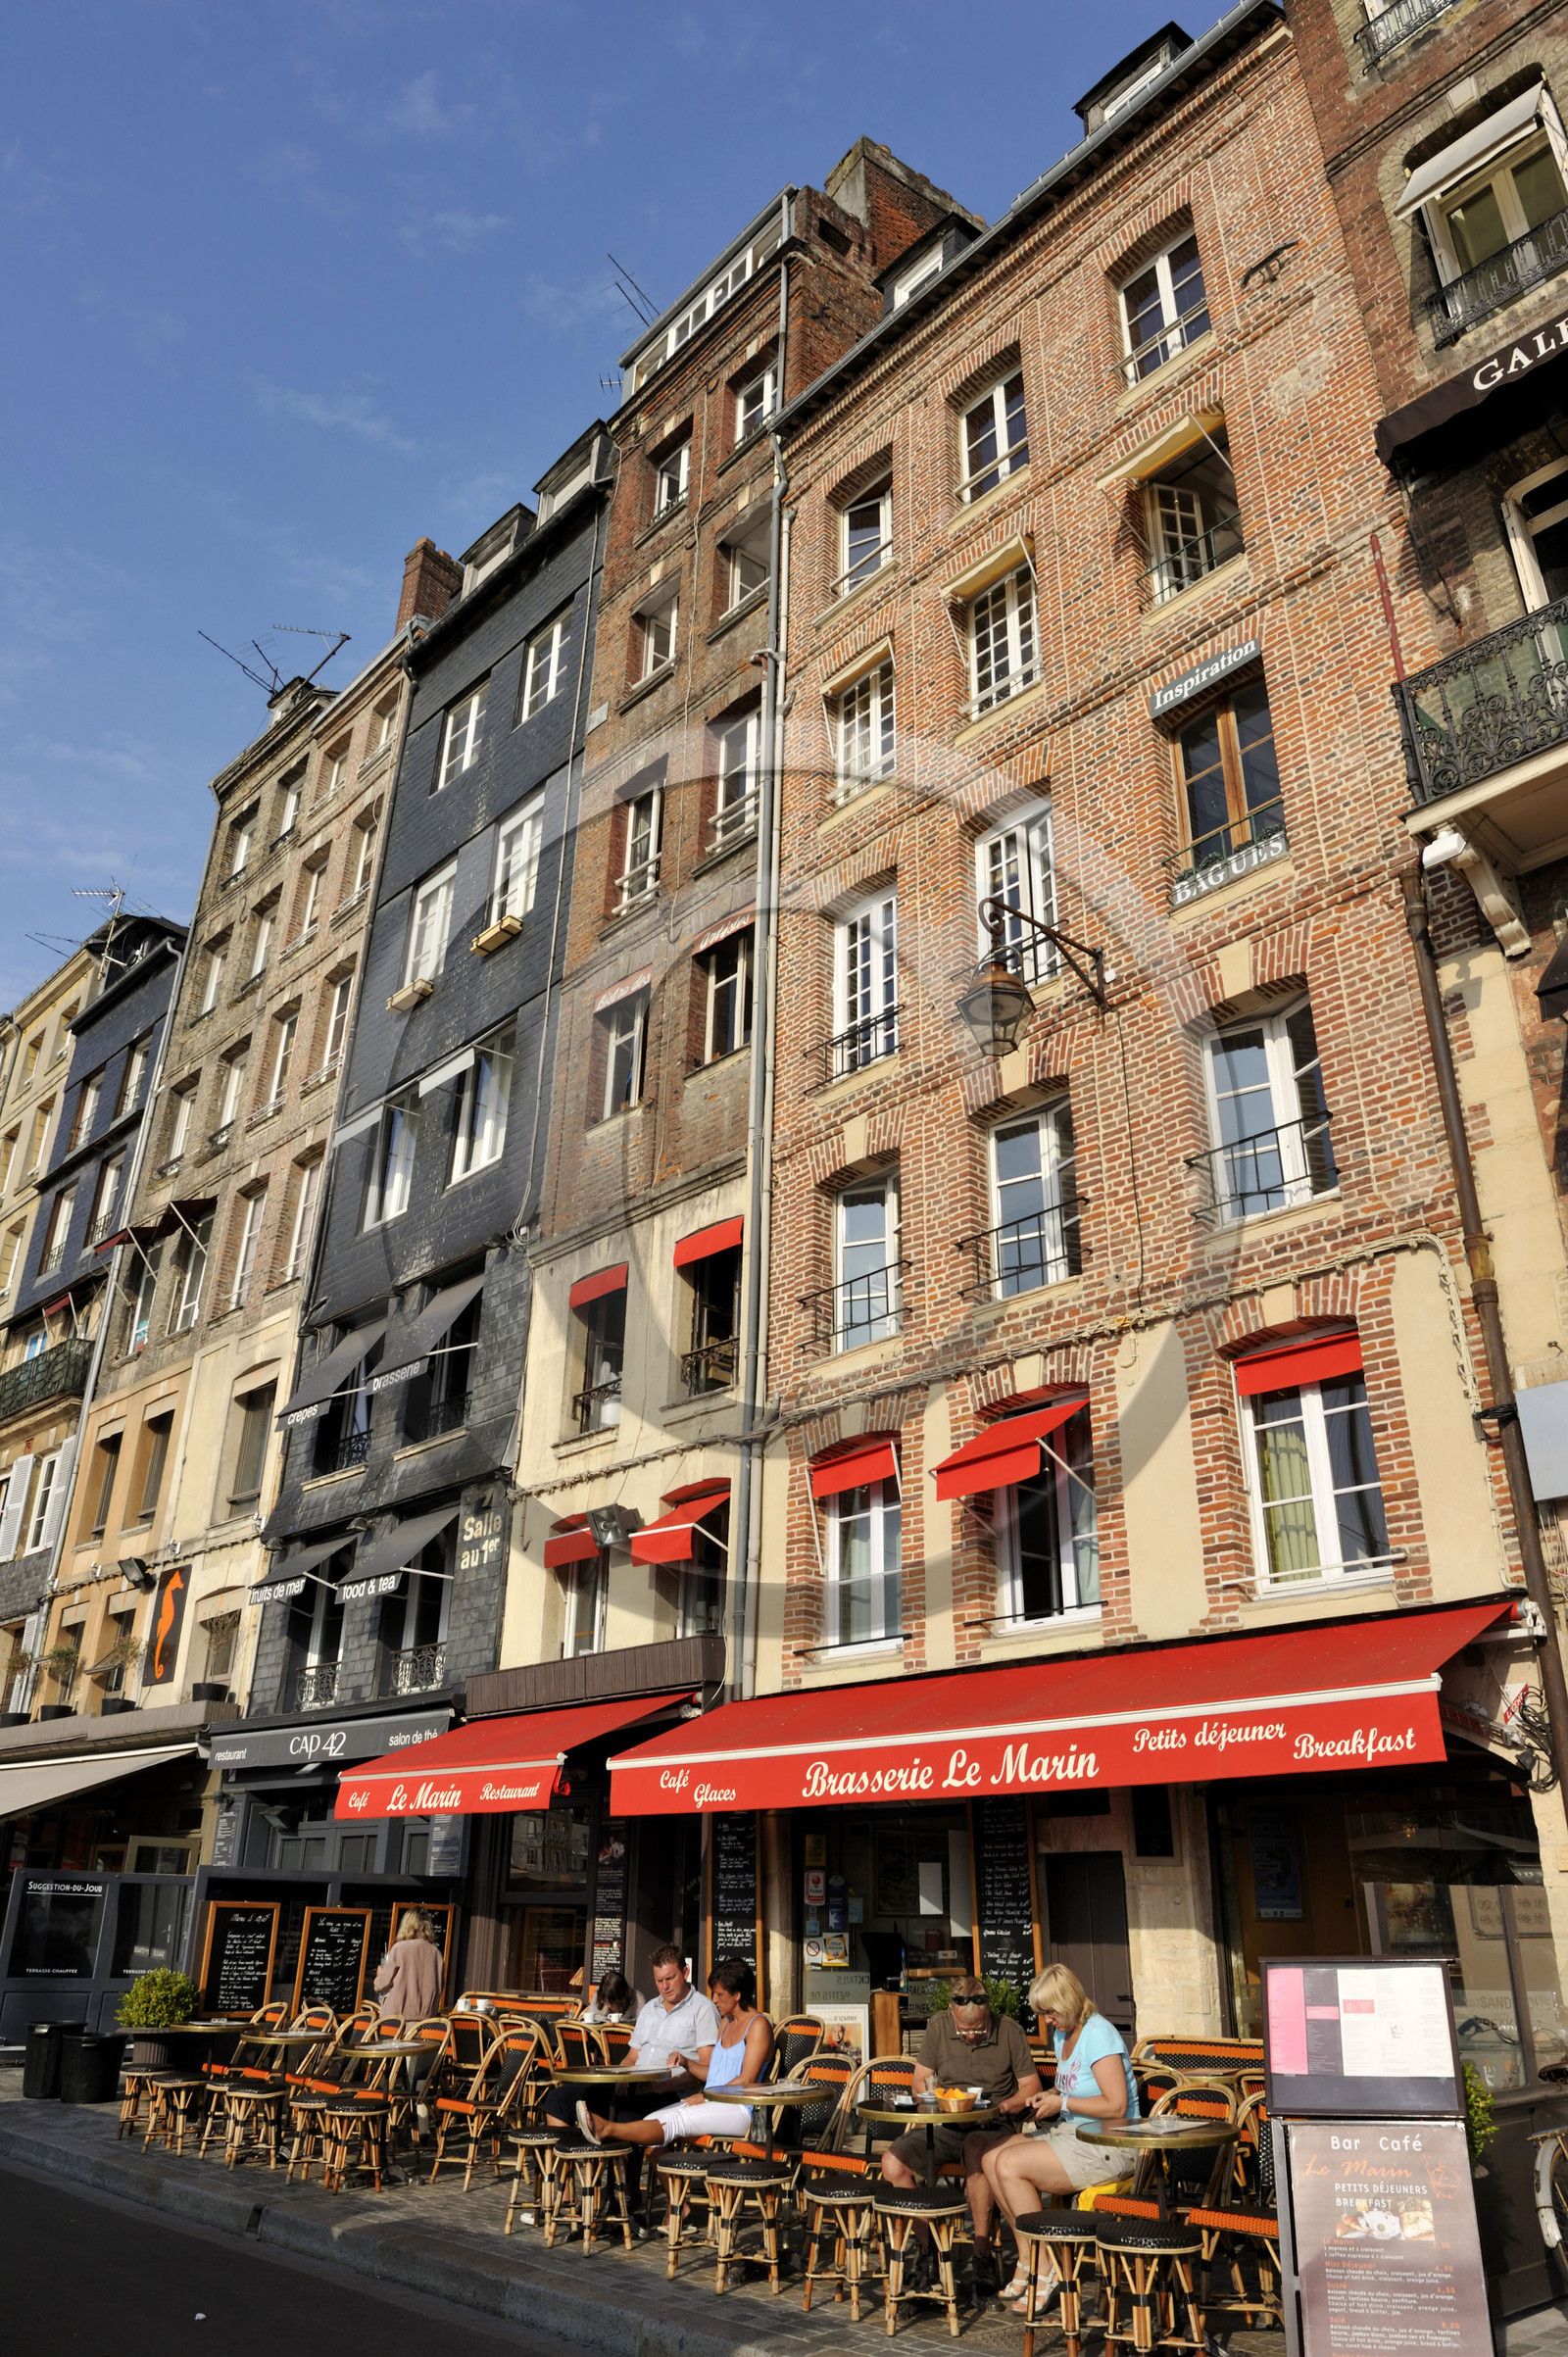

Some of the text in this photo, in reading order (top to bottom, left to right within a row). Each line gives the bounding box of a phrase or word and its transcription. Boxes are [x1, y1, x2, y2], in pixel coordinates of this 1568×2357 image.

[1153, 639, 1256, 711] Inspiration
[1175, 837, 1284, 905] BAGUES
[371, 1360, 421, 1392] brasserie
[463, 1511, 503, 1543] Salle
[459, 1548, 479, 1570] au
[250, 1578, 306, 1604] fruits de mer
[342, 1574, 396, 1601] food & tea
[289, 1731, 347, 1760] CAP 42
[388, 1732, 411, 1747] salon
[412, 1731, 423, 1744] de
[1132, 1721, 1287, 1753] Petits déjeuner
[1293, 1726, 1417, 1762] Breakfast
[214, 1747, 247, 1763] restaurant
[660, 1768, 691, 1793] Café
[802, 1742, 1101, 1798] Brasserie Le Marin
[348, 1791, 371, 1812] Café
[385, 1781, 463, 1811] Le Marin
[479, 1781, 541, 1800] Restaurant
[693, 1782, 737, 1808] Glaces
[1330, 2133, 1423, 2152] Bar Café
[1300, 2153, 1414, 2179] Le Marin
[1335, 2181, 1428, 2194] PETITS DÉJEUNERS
[1336, 2197, 1393, 2209] BREAKFAST
[1326, 2281, 1348, 2289] Sucré
